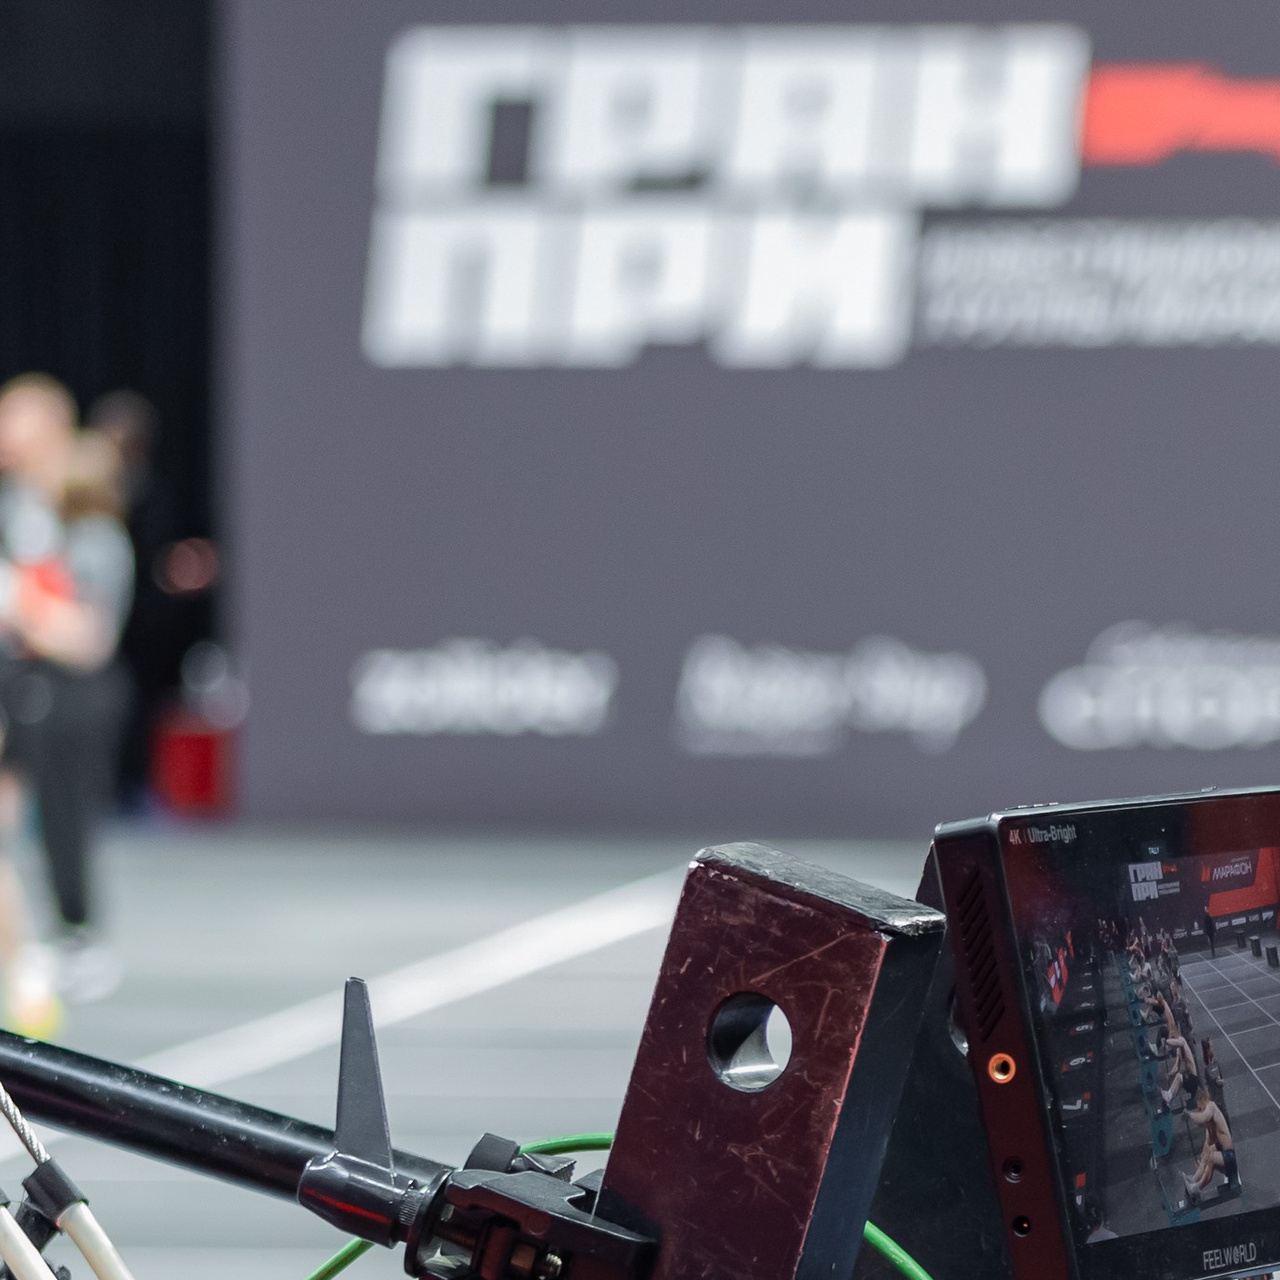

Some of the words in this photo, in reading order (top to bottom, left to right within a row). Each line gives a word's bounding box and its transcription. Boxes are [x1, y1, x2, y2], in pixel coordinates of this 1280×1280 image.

[378, 25, 1091, 204] ГРАН
[1009, 828, 1022, 845] 4K
[1027, 824, 1077, 844] Ultra-Bright
[1203, 1242, 1257, 1271] FEELWORLD
